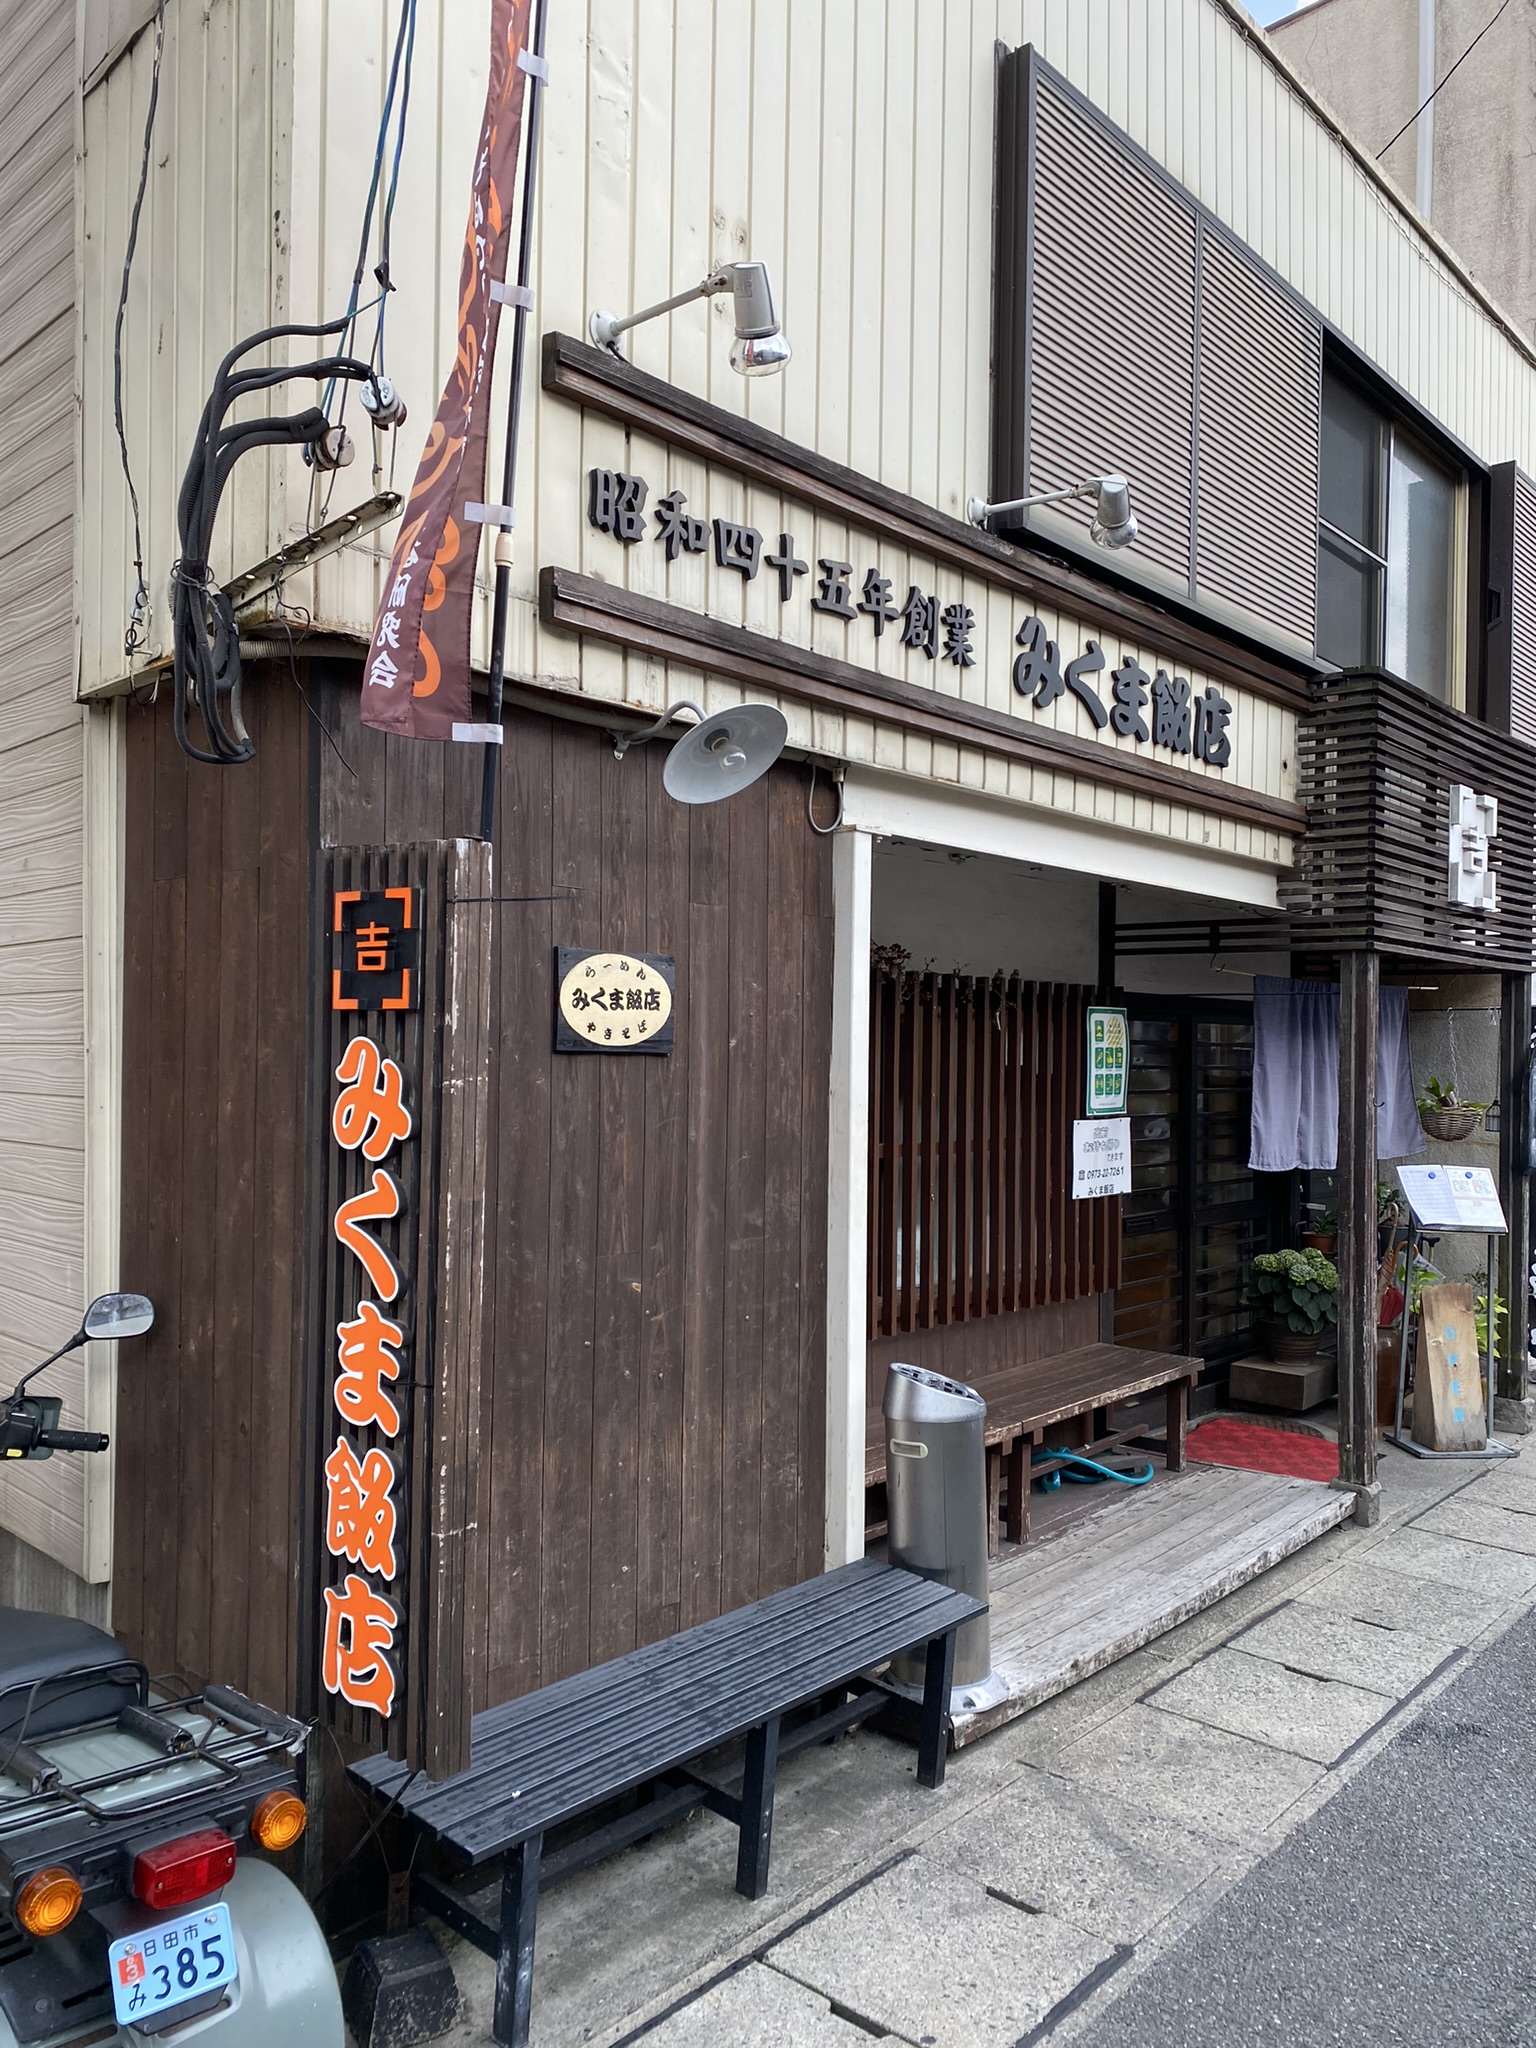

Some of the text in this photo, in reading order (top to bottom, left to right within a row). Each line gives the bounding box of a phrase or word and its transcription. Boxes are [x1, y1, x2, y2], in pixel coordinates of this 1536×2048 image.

[588, 466, 1233, 768] 昭和四十五年創業 みくま飯店
[356, 921, 390, 971] 吉
[571, 986, 661, 1012] みくま飯店
[586, 1019, 648, 1040] やきそば
[1086, 1166, 1124, 1180] 0973-22-7261
[1088, 1184, 1115, 1196] みくま飯店
[322, 1034, 413, 1720] みくま飯店
[1444, 1325, 1465, 1423] OPEN
[143, 1923, 199, 1957] 日田市
[128, 1934, 225, 2011] み 385
